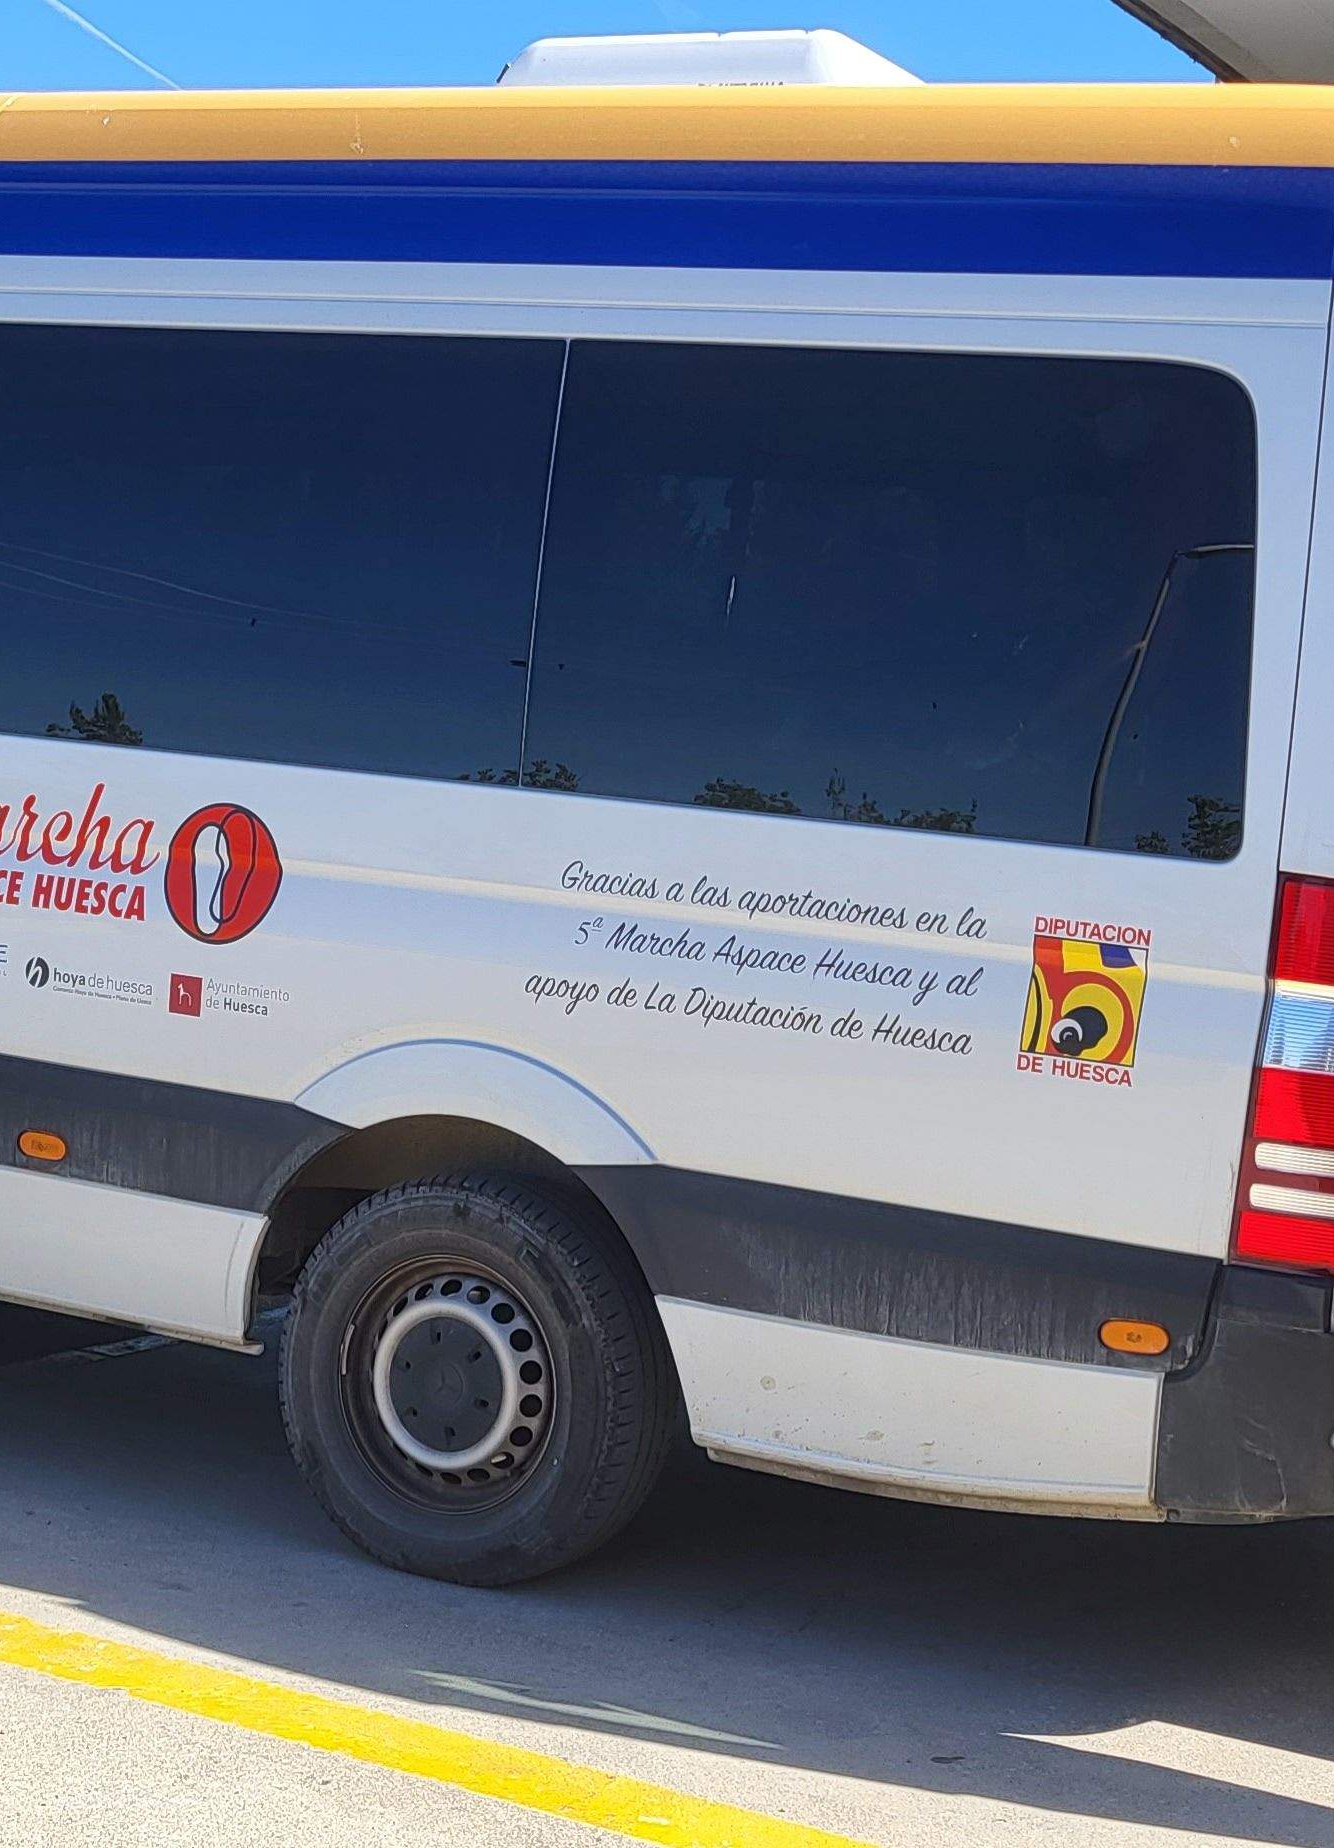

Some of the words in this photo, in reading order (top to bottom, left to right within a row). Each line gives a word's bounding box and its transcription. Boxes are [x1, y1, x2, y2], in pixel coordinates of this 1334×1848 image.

[31, 872, 147, 922] HUESCA
[561, 860, 659, 899] Gracias
[666, 882, 685, 902] a
[690, 875, 733, 908] las
[738, 889, 909, 931] aportaciones
[915, 911, 949, 935] en
[955, 906, 988, 939] la
[1034, 915, 1152, 947] DIPUTACION
[604, 921, 707, 962] Marcha
[712, 934, 807, 976] Aspace
[812, 947, 913, 989] Huesca
[912, 970, 939, 1006] y
[946, 966, 984, 997] al
[53, 968, 86, 987] hoya
[88, 973, 105, 989] de
[107, 975, 153, 996] huesca
[207, 978, 291, 1002] Ayuntamiento
[206, 996, 220, 1010] de
[223, 997, 268, 1016] Huesca
[524, 974, 600, 1015] apoyo
[607, 977, 638, 1008] de
[644, 981, 677, 1014] La
[683, 986, 824, 1035] Diputación
[830, 1008, 864, 1040] de
[872, 1012, 973, 1056] Huesca
[1016, 1053, 1044, 1075] DE
[1050, 1057, 1135, 1088] HUESCA
